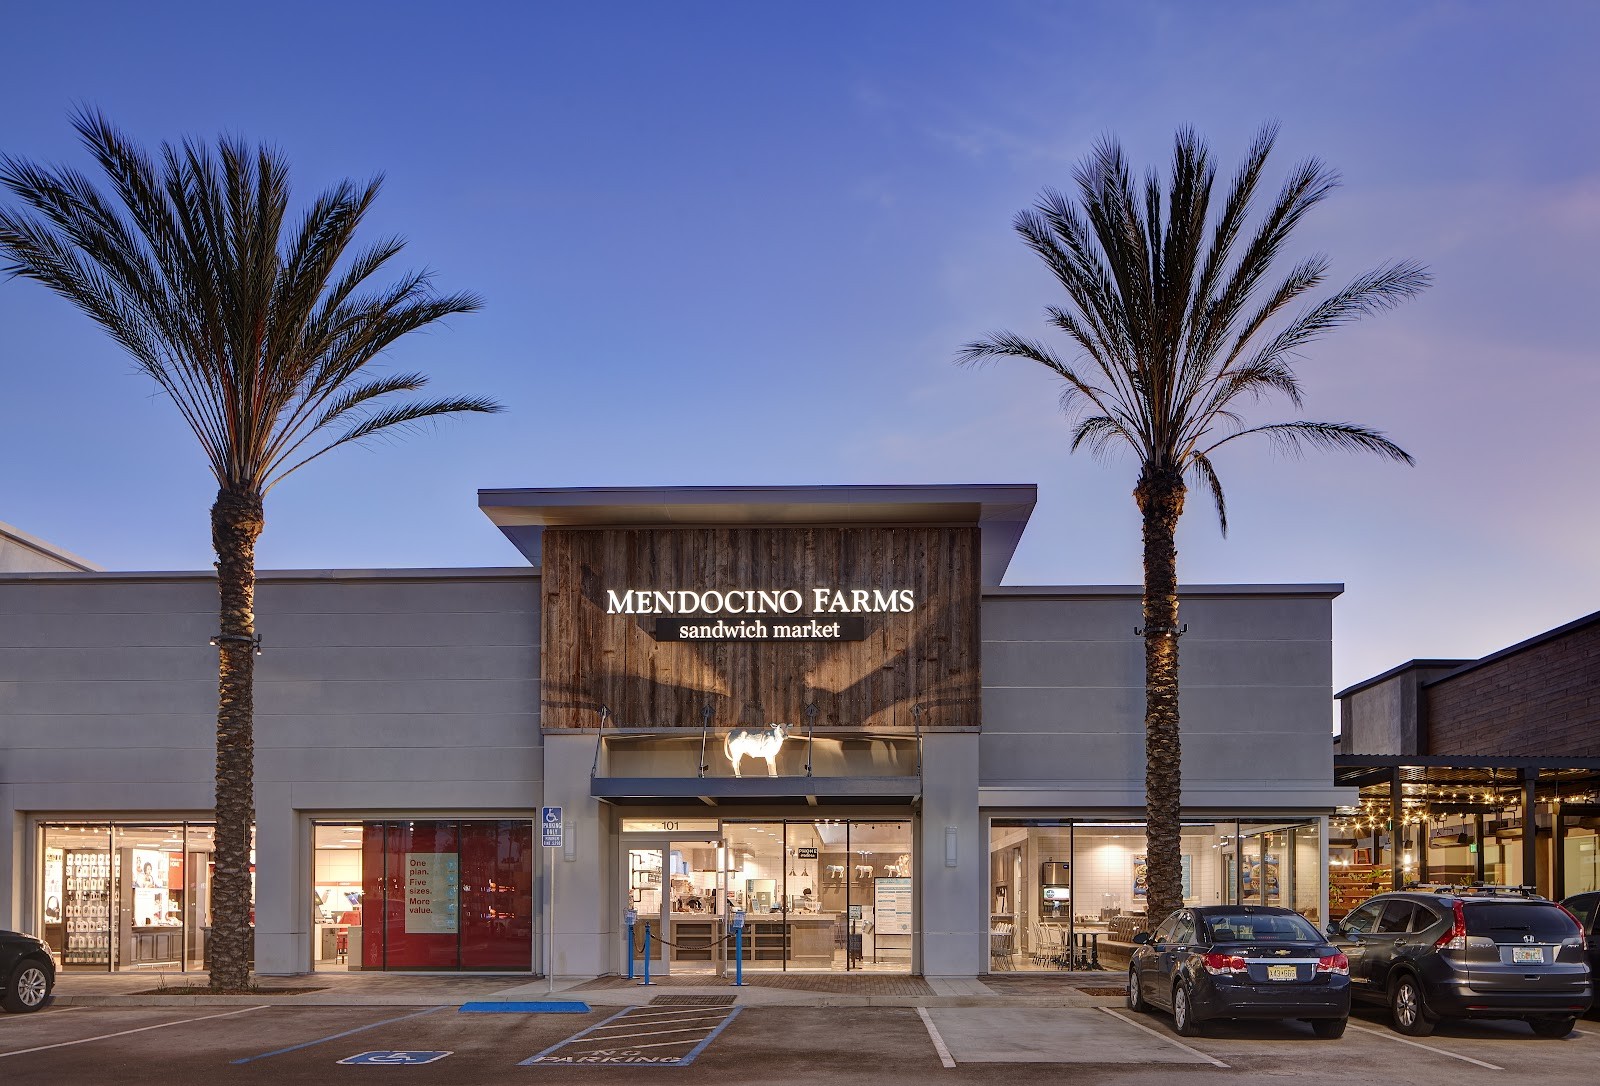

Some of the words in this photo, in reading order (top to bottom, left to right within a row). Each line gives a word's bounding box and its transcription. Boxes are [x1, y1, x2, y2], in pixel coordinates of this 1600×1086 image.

[606, 589, 803, 614] MENDOCINO
[812, 588, 915, 613] FARMS
[679, 620, 768, 639] sandwich
[772, 620, 841, 638] market
[662, 821, 679, 830] 101
[409, 868, 429, 876] plan.
